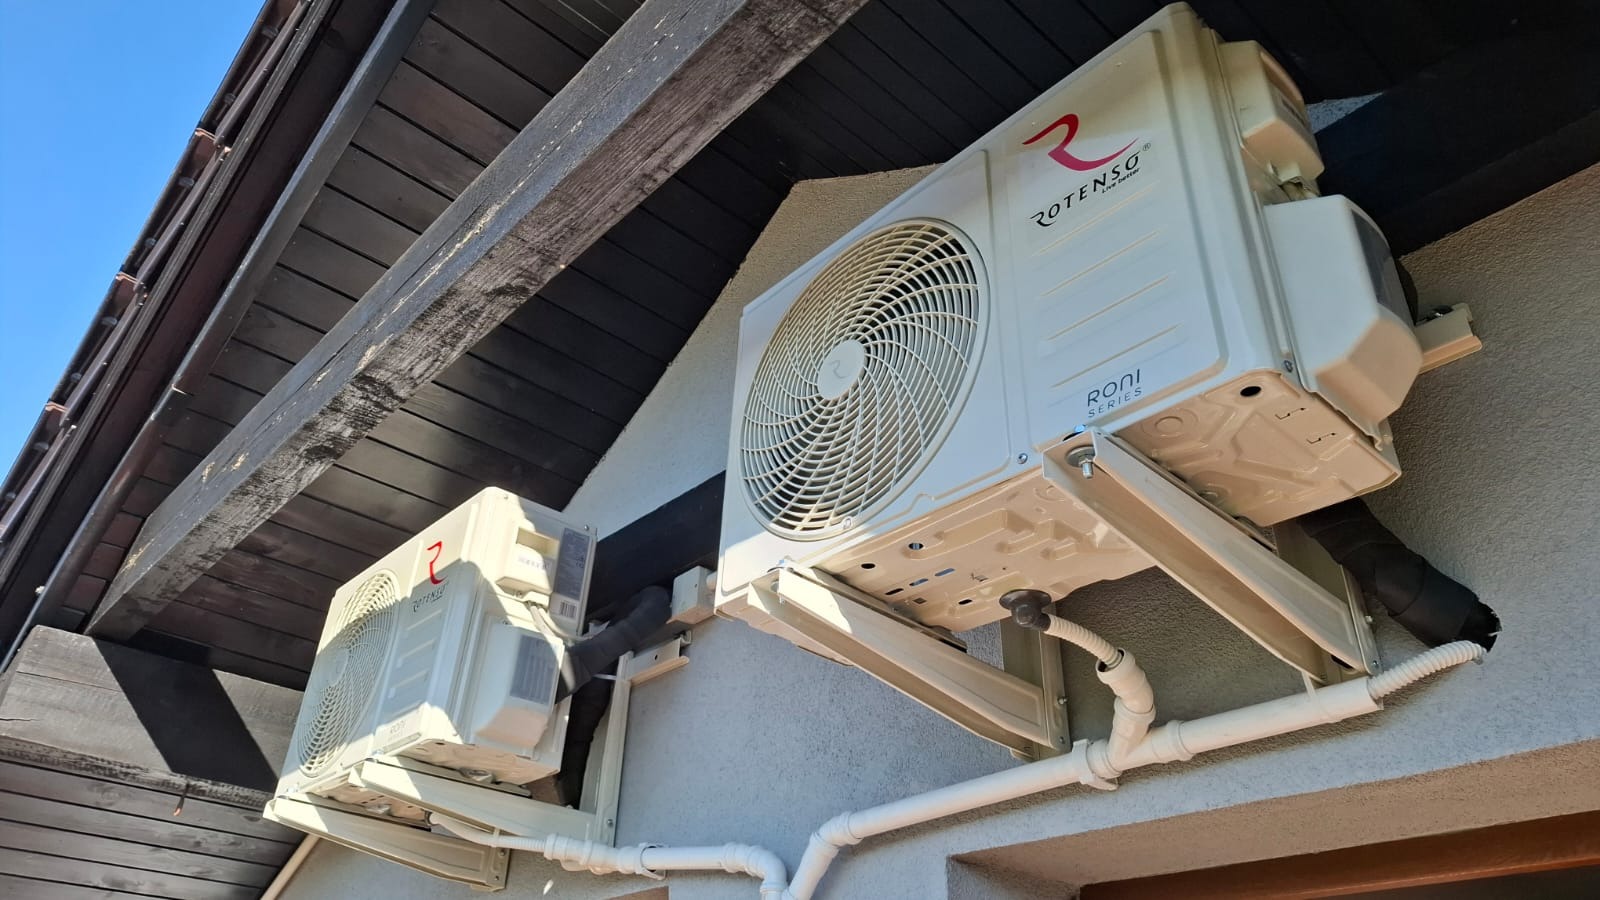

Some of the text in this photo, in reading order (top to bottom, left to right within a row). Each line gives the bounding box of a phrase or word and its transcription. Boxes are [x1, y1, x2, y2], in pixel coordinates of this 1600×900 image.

[1030, 150, 1141, 227] ROTENSO
[1101, 167, 1140, 194] Live better
[1087, 386, 1142, 418] SERIES
